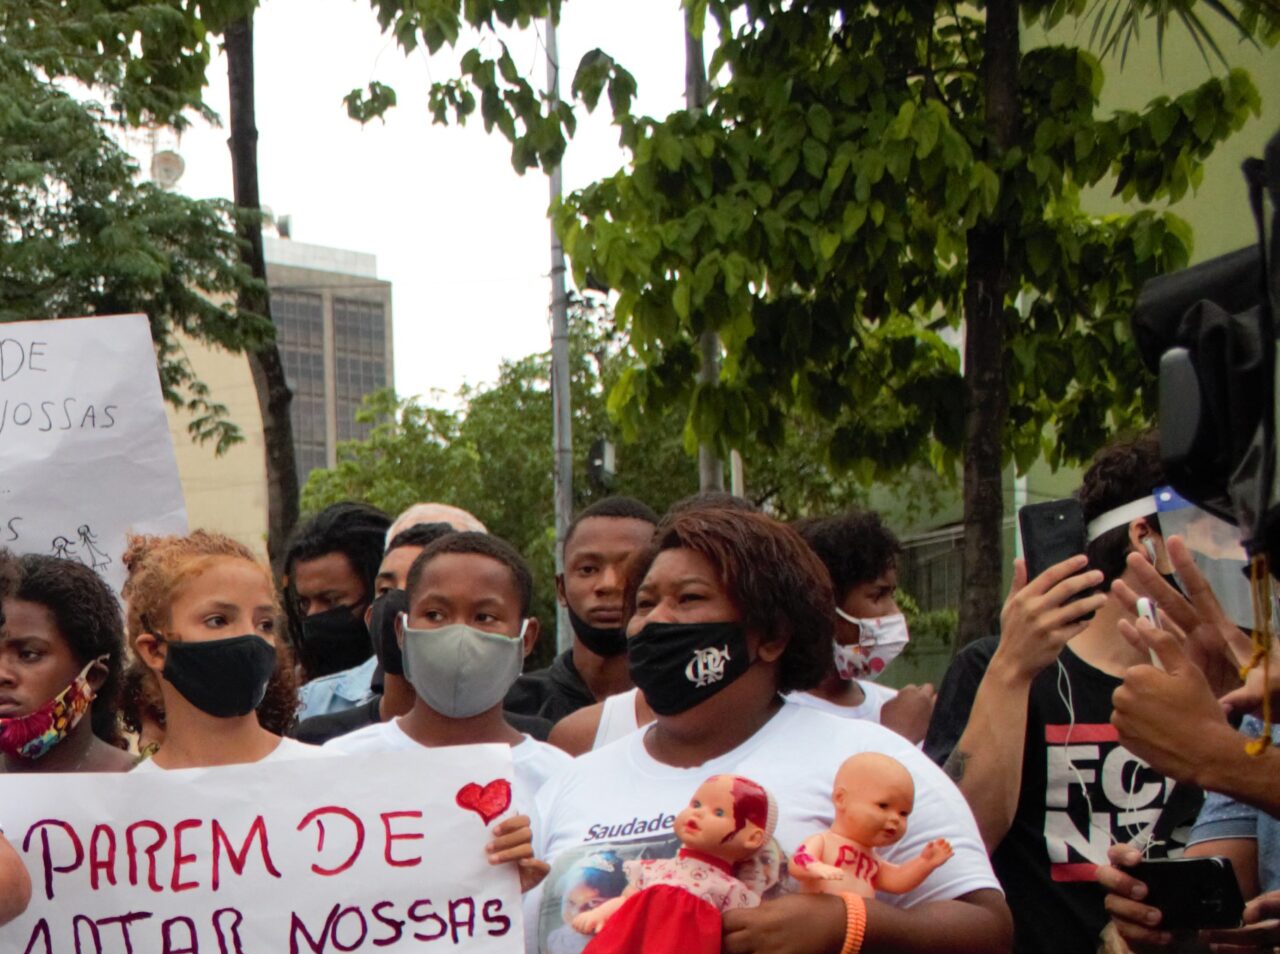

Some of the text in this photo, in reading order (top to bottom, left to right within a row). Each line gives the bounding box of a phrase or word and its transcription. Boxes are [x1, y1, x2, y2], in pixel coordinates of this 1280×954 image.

[0, 338, 47, 382] DE
[1046, 744, 1177, 811] FC
[23, 806, 425, 900] PAREM DE
[583, 811, 677, 842] Saudade
[1044, 808, 1190, 866] NZ
